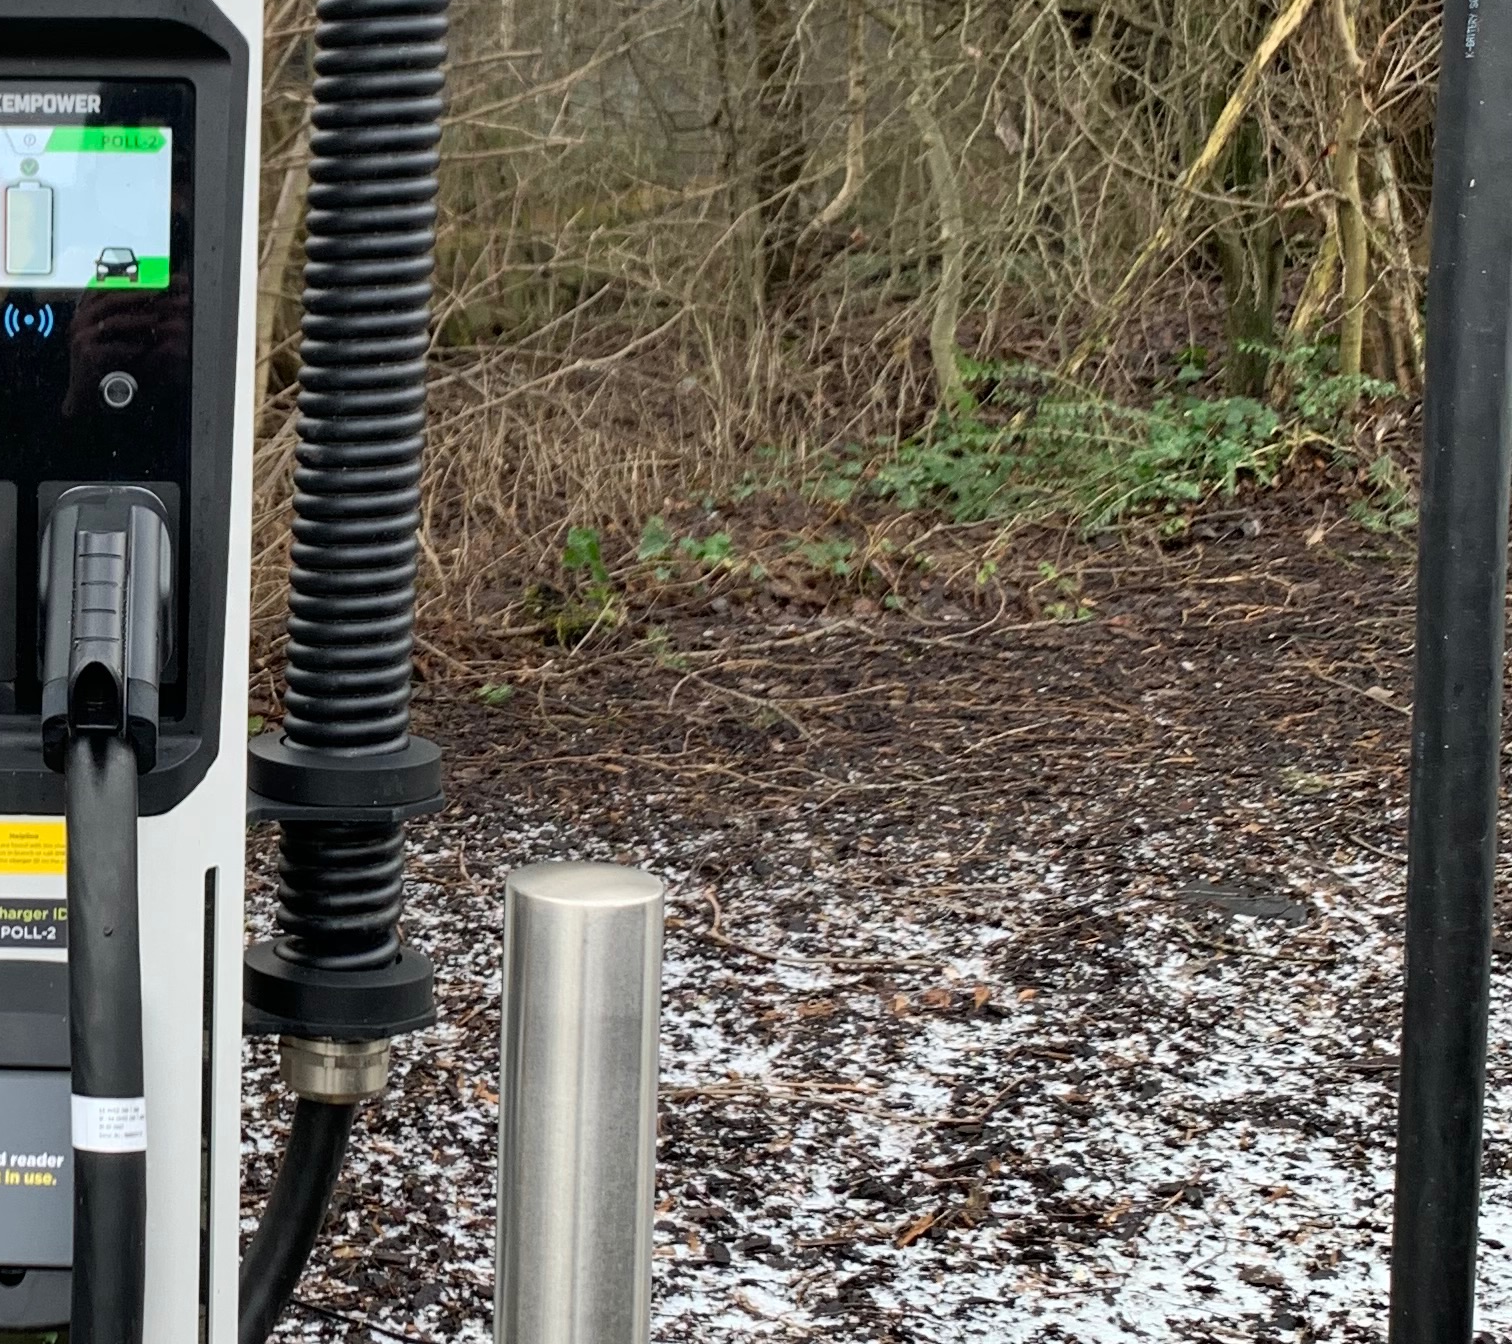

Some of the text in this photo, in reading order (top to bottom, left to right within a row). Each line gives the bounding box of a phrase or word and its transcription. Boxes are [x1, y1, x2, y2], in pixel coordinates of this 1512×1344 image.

[101, 134, 159, 148] POLL-2
[53, 908, 68, 921] ID
[0, 925, 57, 940] POLL-2
[10, 1151, 65, 1168] reader
[4, 1169, 20, 1185] in
[24, 1171, 57, 1186] use.
